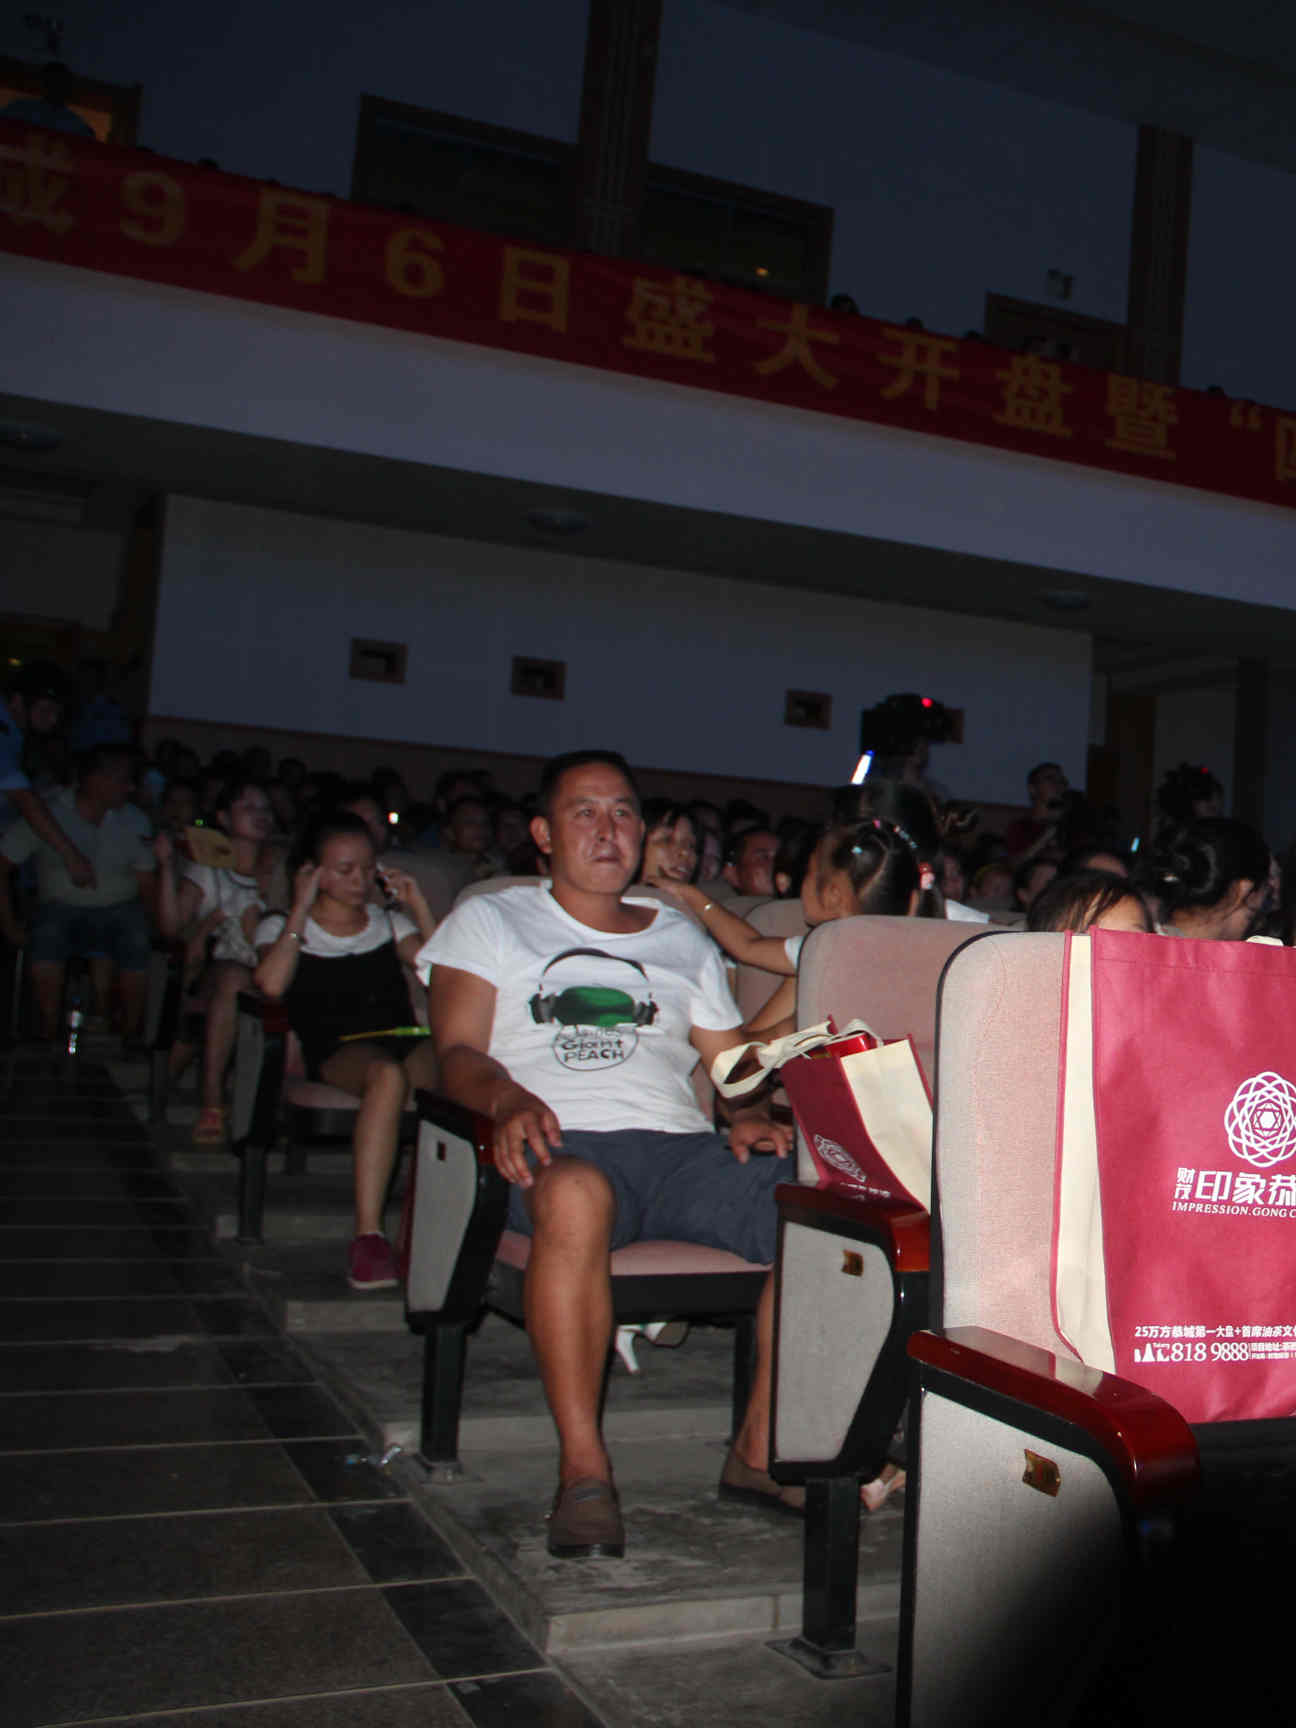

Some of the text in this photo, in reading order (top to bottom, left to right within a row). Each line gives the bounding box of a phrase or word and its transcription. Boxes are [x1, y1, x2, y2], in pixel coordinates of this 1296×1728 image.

[562, 1038, 625, 1051] Giant
[564, 1048, 625, 1063] PEACH
[1170, 1342, 1208, 1362] 818
[1210, 1341, 1249, 1362] 9888
